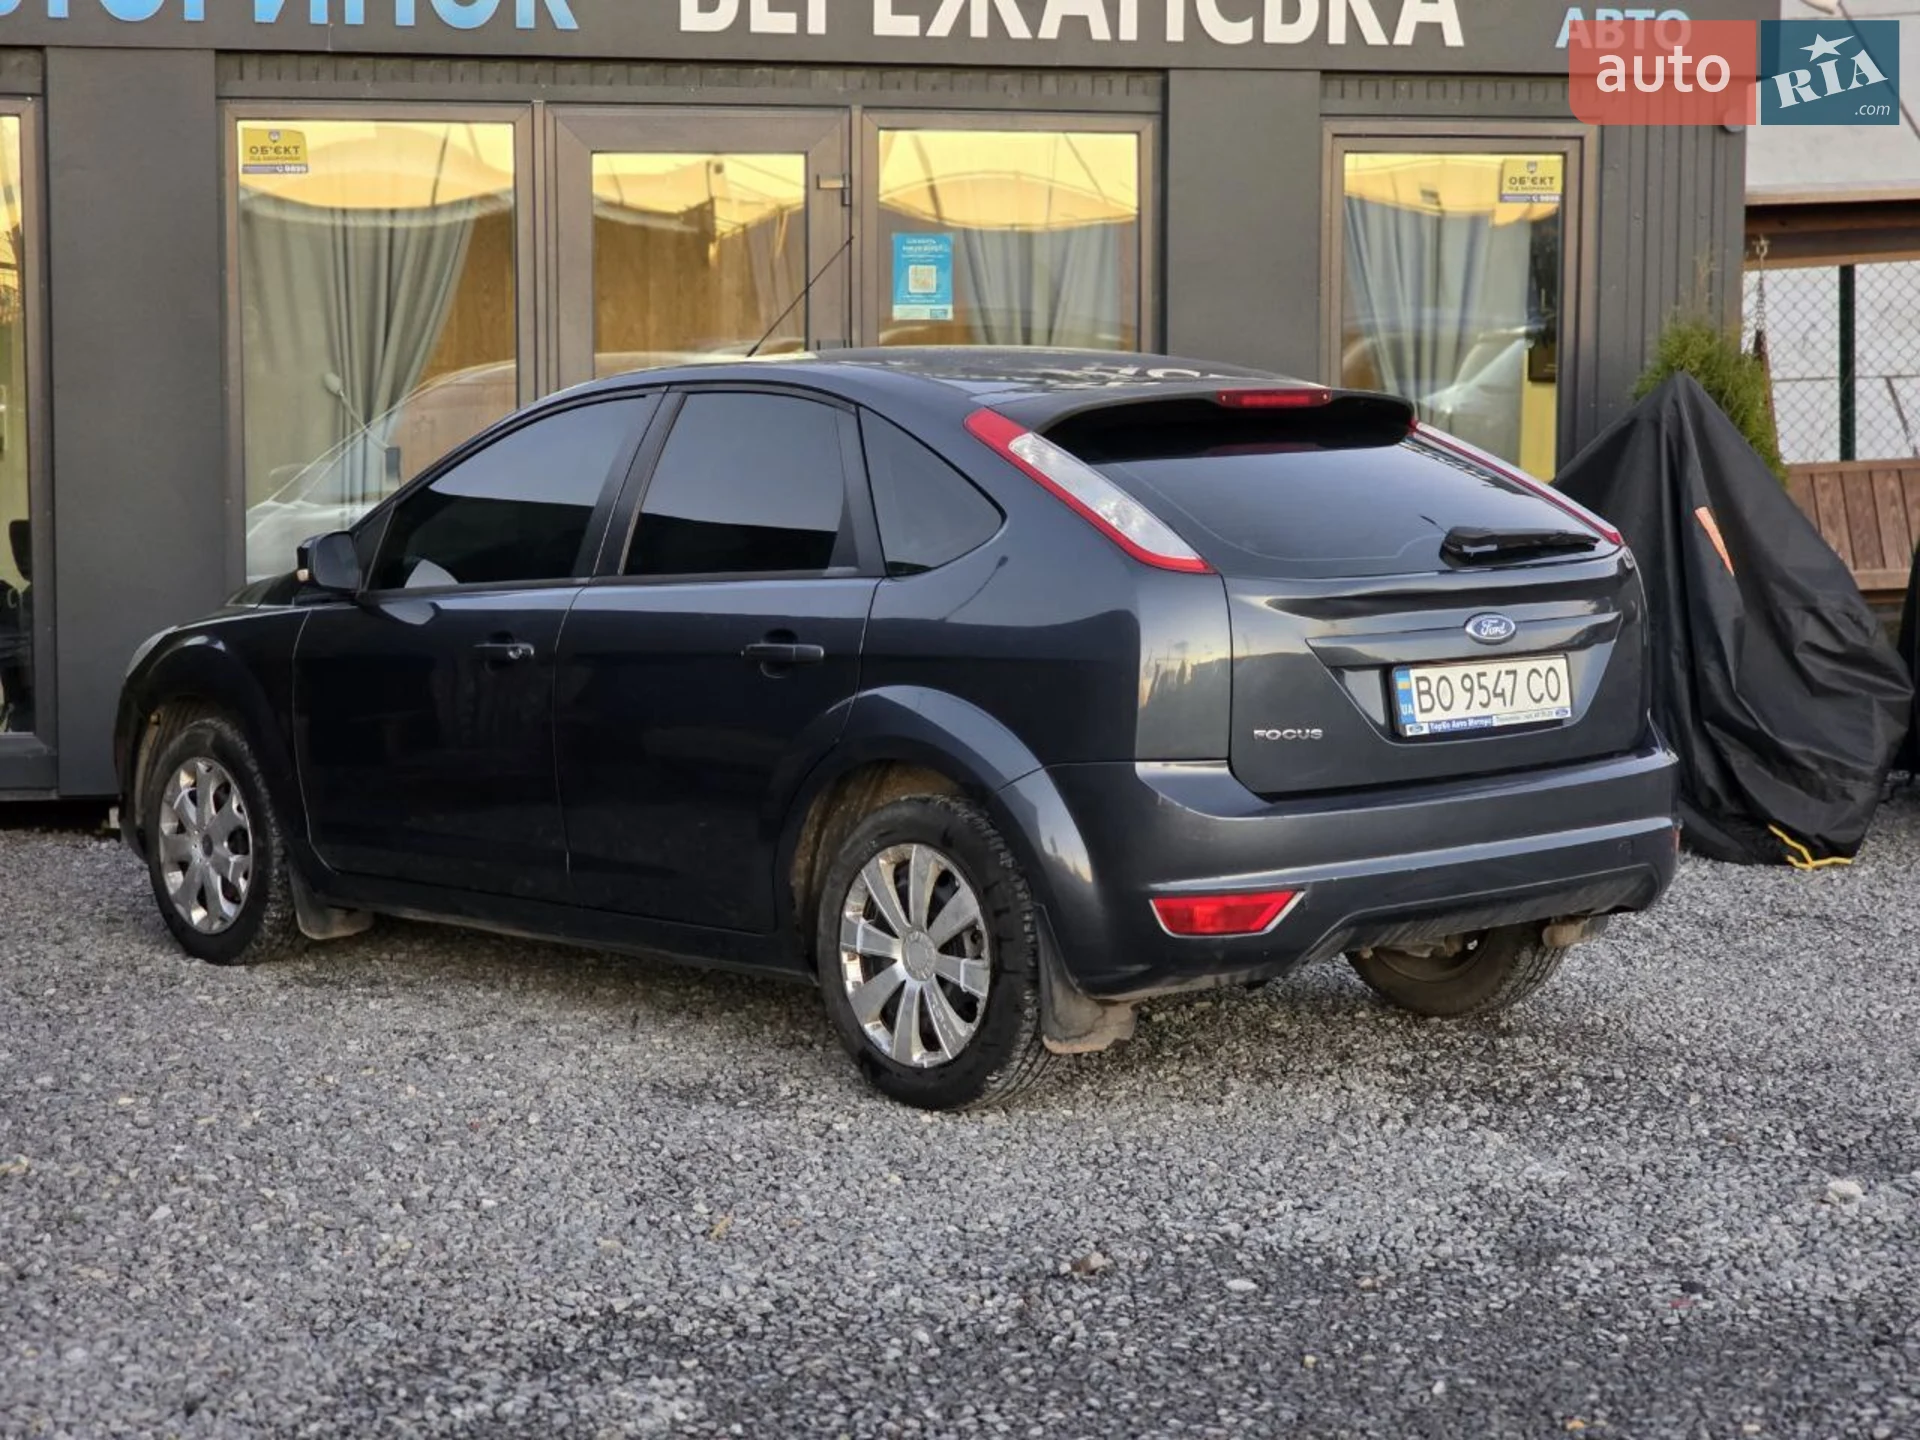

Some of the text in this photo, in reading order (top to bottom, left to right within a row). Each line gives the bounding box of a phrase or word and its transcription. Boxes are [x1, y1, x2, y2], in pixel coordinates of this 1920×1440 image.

[1555, 8, 1692, 50] АВТО
[1414, 666, 1561, 714] BO 9547 CO
[1401, 703, 1414, 716] UA
[1253, 728, 1323, 741] FOCUS
